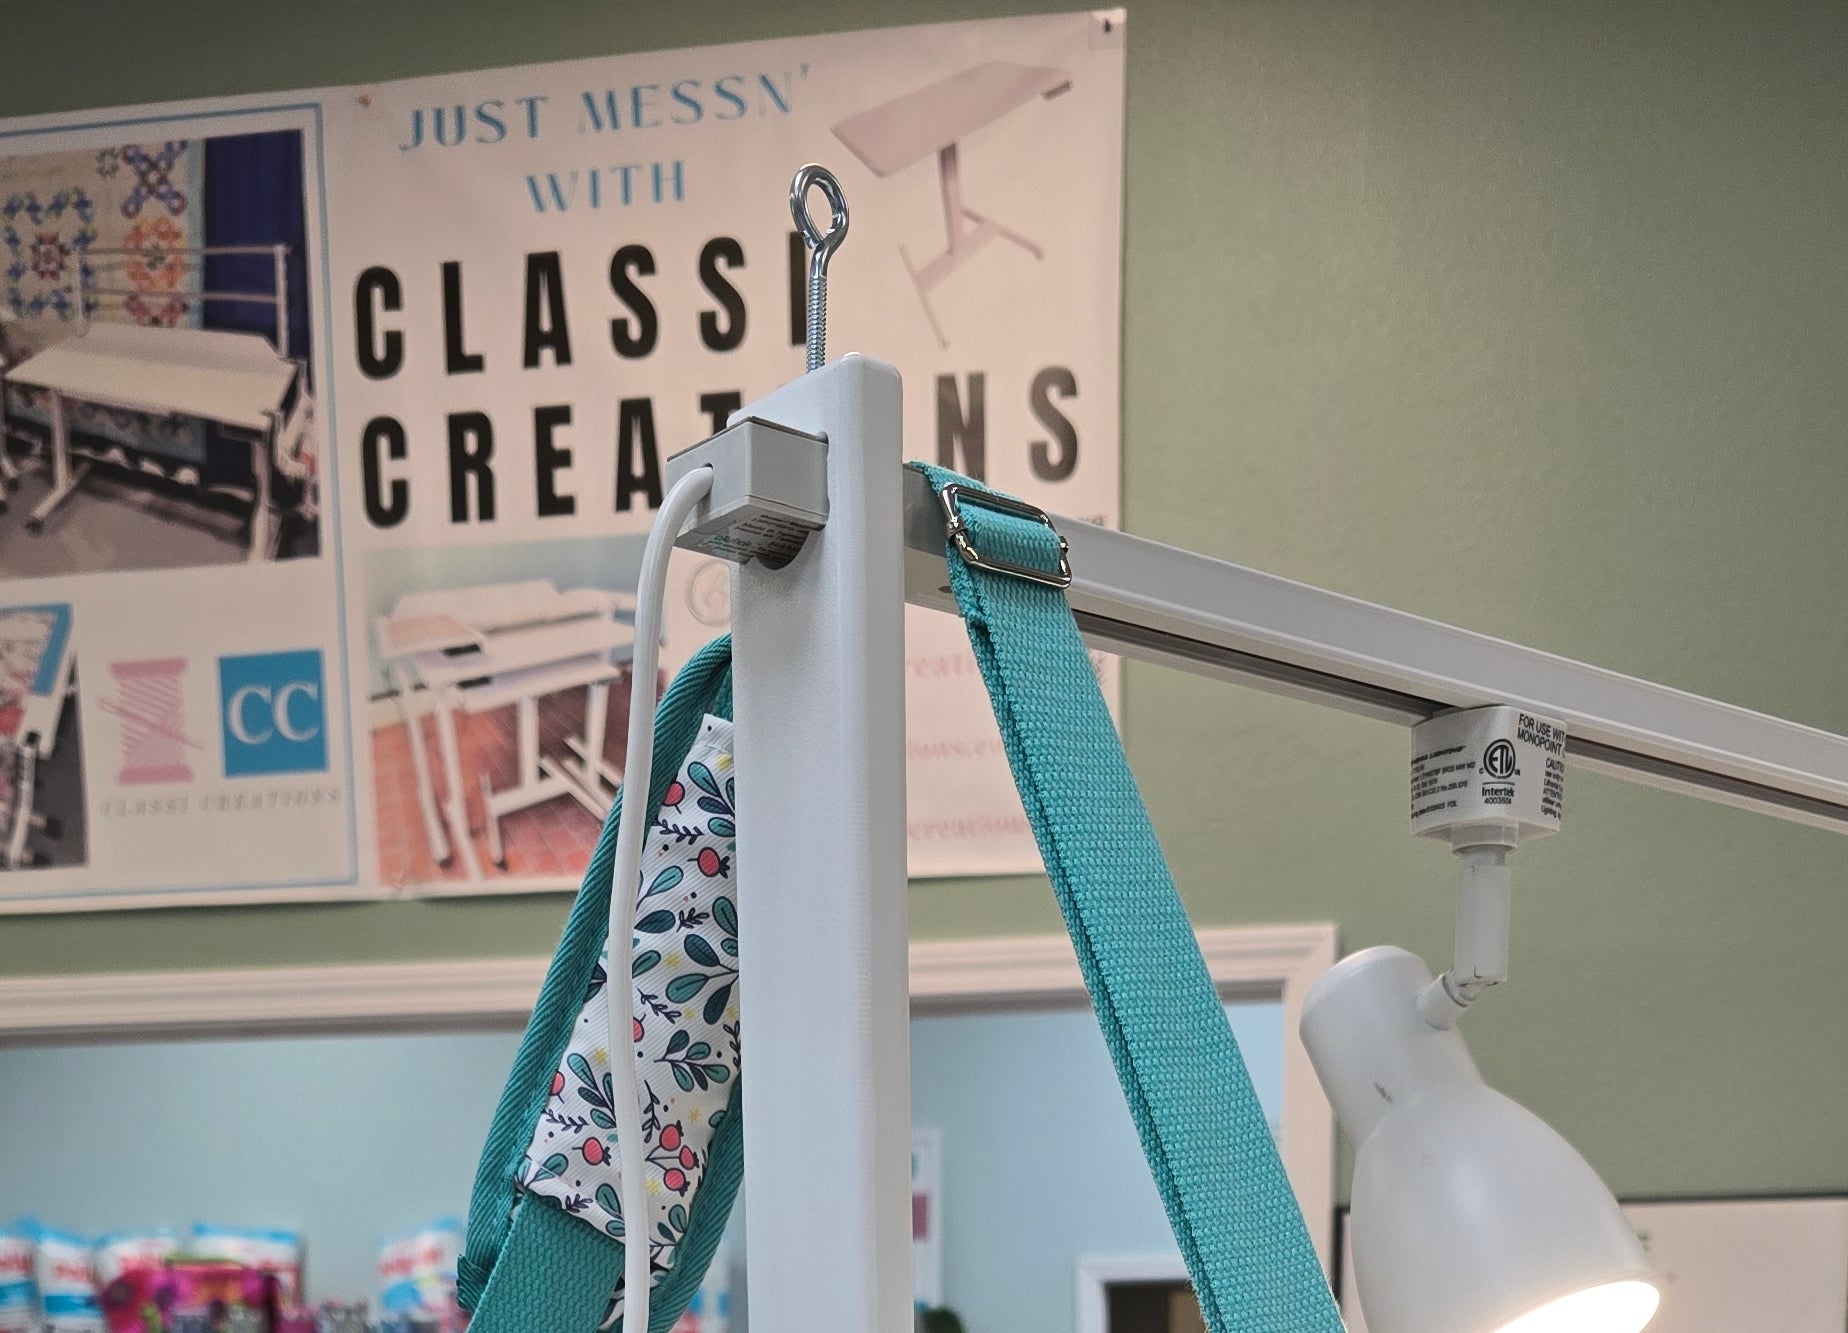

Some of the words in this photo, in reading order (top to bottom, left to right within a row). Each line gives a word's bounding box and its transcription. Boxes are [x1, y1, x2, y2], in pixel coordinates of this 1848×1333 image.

[398, 95, 548, 153] JUST
[578, 63, 811, 136] MESSN'
[525, 159, 686, 214] WITH
[227, 680, 321, 745] CC
[1518, 713, 1535, 731] FOR
[1535, 719, 1551, 737] USE
[1517, 727, 1562, 756] MONOPOINT
[1482, 787, 1515, 799] Intertek
